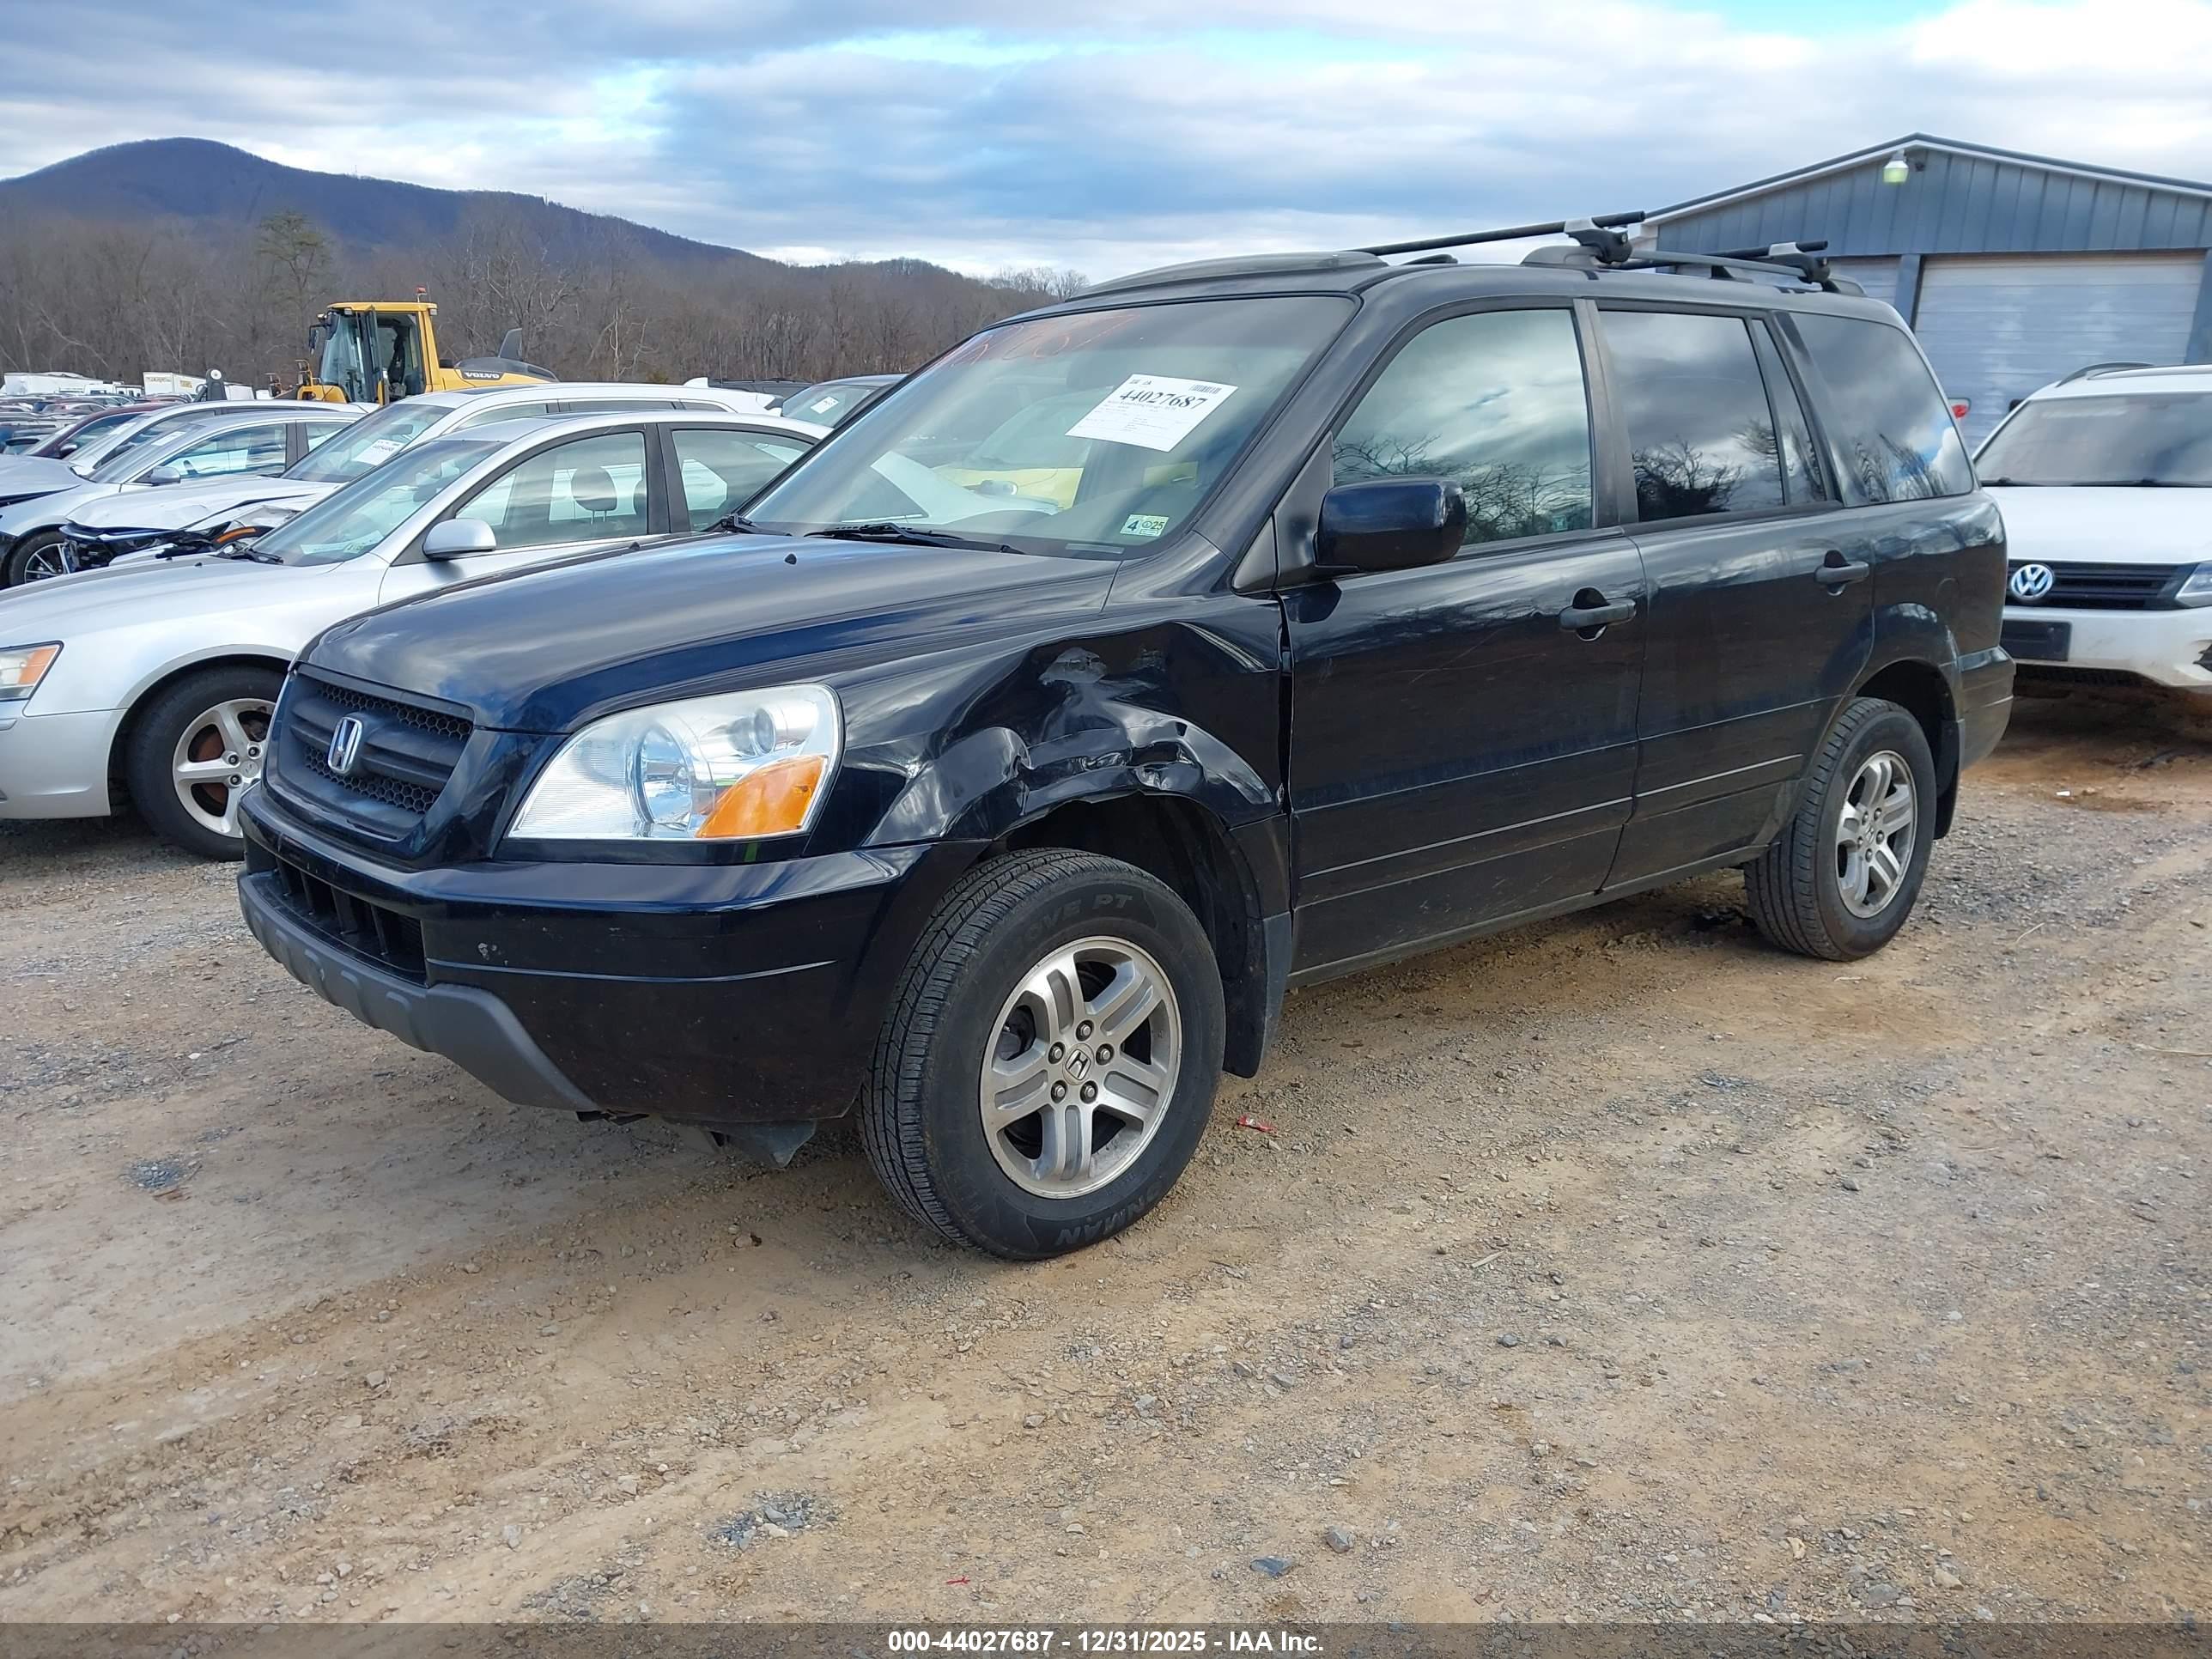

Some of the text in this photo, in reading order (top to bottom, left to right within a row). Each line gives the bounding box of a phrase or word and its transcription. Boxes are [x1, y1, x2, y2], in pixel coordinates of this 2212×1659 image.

[1120, 389, 1207, 410] 44027687
[1127, 520, 1164, 531] 4 25
[1092, 893, 1133, 910] PT
